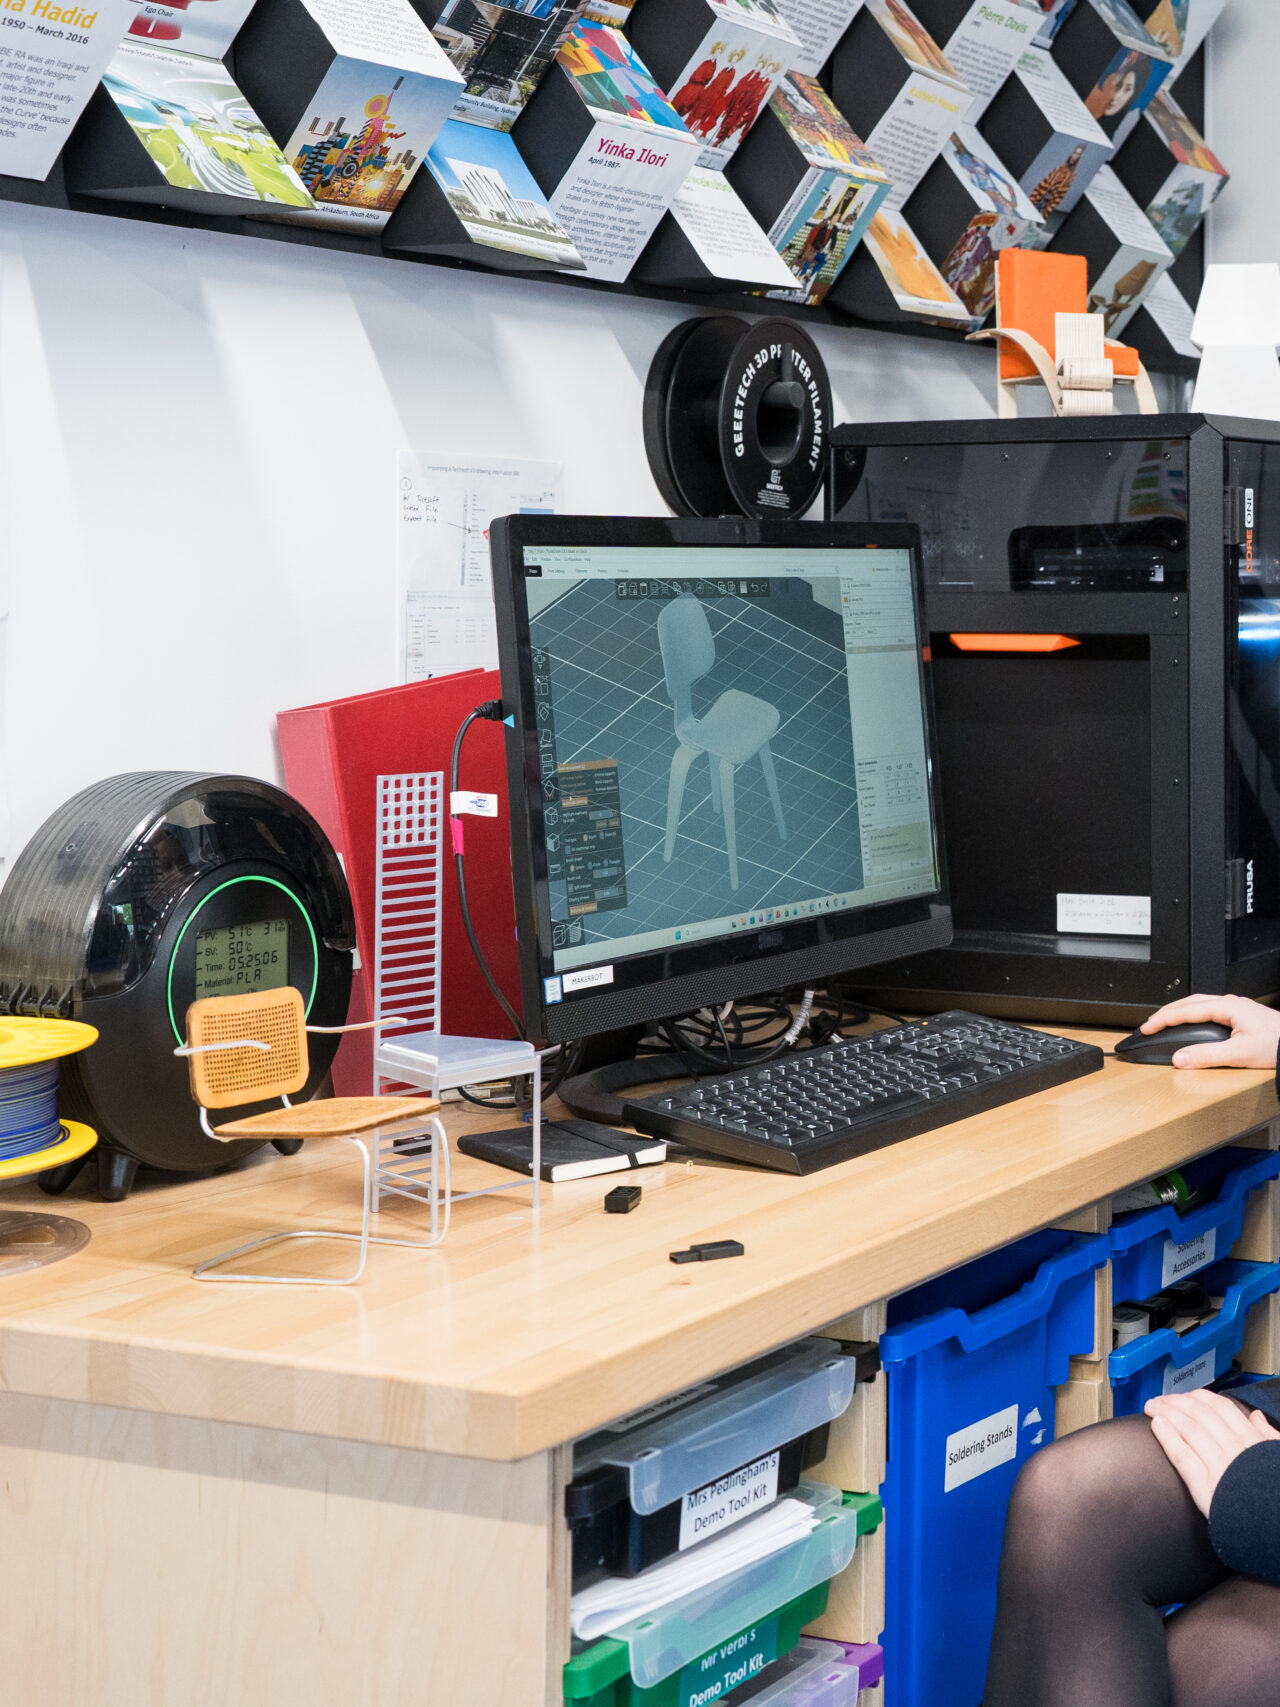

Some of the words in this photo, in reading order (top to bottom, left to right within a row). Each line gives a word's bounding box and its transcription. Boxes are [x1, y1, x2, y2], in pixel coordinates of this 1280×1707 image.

[31, 0, 98, 29] Hadid
[145, 5, 157, 14] Ego
[157, 8, 174, 17] Chair
[977, 5, 1005, 25] Pierre
[1, 17, 26, 30] 1950
[35, 25, 64, 39] March
[65, 32, 89, 45] 2016
[28, 54, 43, 63] was
[588, 156, 603, 167] April
[597, 138, 636, 160] Yinka
[636, 148, 670, 168] Ilori
[754, 348, 770, 369] 3D
[770, 343, 812, 383] PRTER
[808, 380, 823, 472] FILAMENT
[1245, 859, 1254, 914] PRUSA
[204, 931, 218, 941] PV:
[205, 947, 218, 957] SV:
[204, 975, 235, 989] Material:
[236, 968, 262, 985] PLA
[205, 963, 225, 973] Time:
[571, 972, 603, 985] MAKERBOT
[1173, 1250, 1206, 1276] Accessories
[948, 1440, 985, 1466] Soldering
[986, 1424, 1013, 1447] Stands
[687, 1490, 709, 1511] Mrs
[710, 1454, 777, 1499] Pedlingham's
[694, 1507, 726, 1533] Demo
[729, 1489, 751, 1514] Tool
[753, 1483, 767, 1502] Kit
[689, 1681, 722, 1707] Demo
[724, 1660, 747, 1689] Tool
[749, 1652, 764, 1673] Kit
